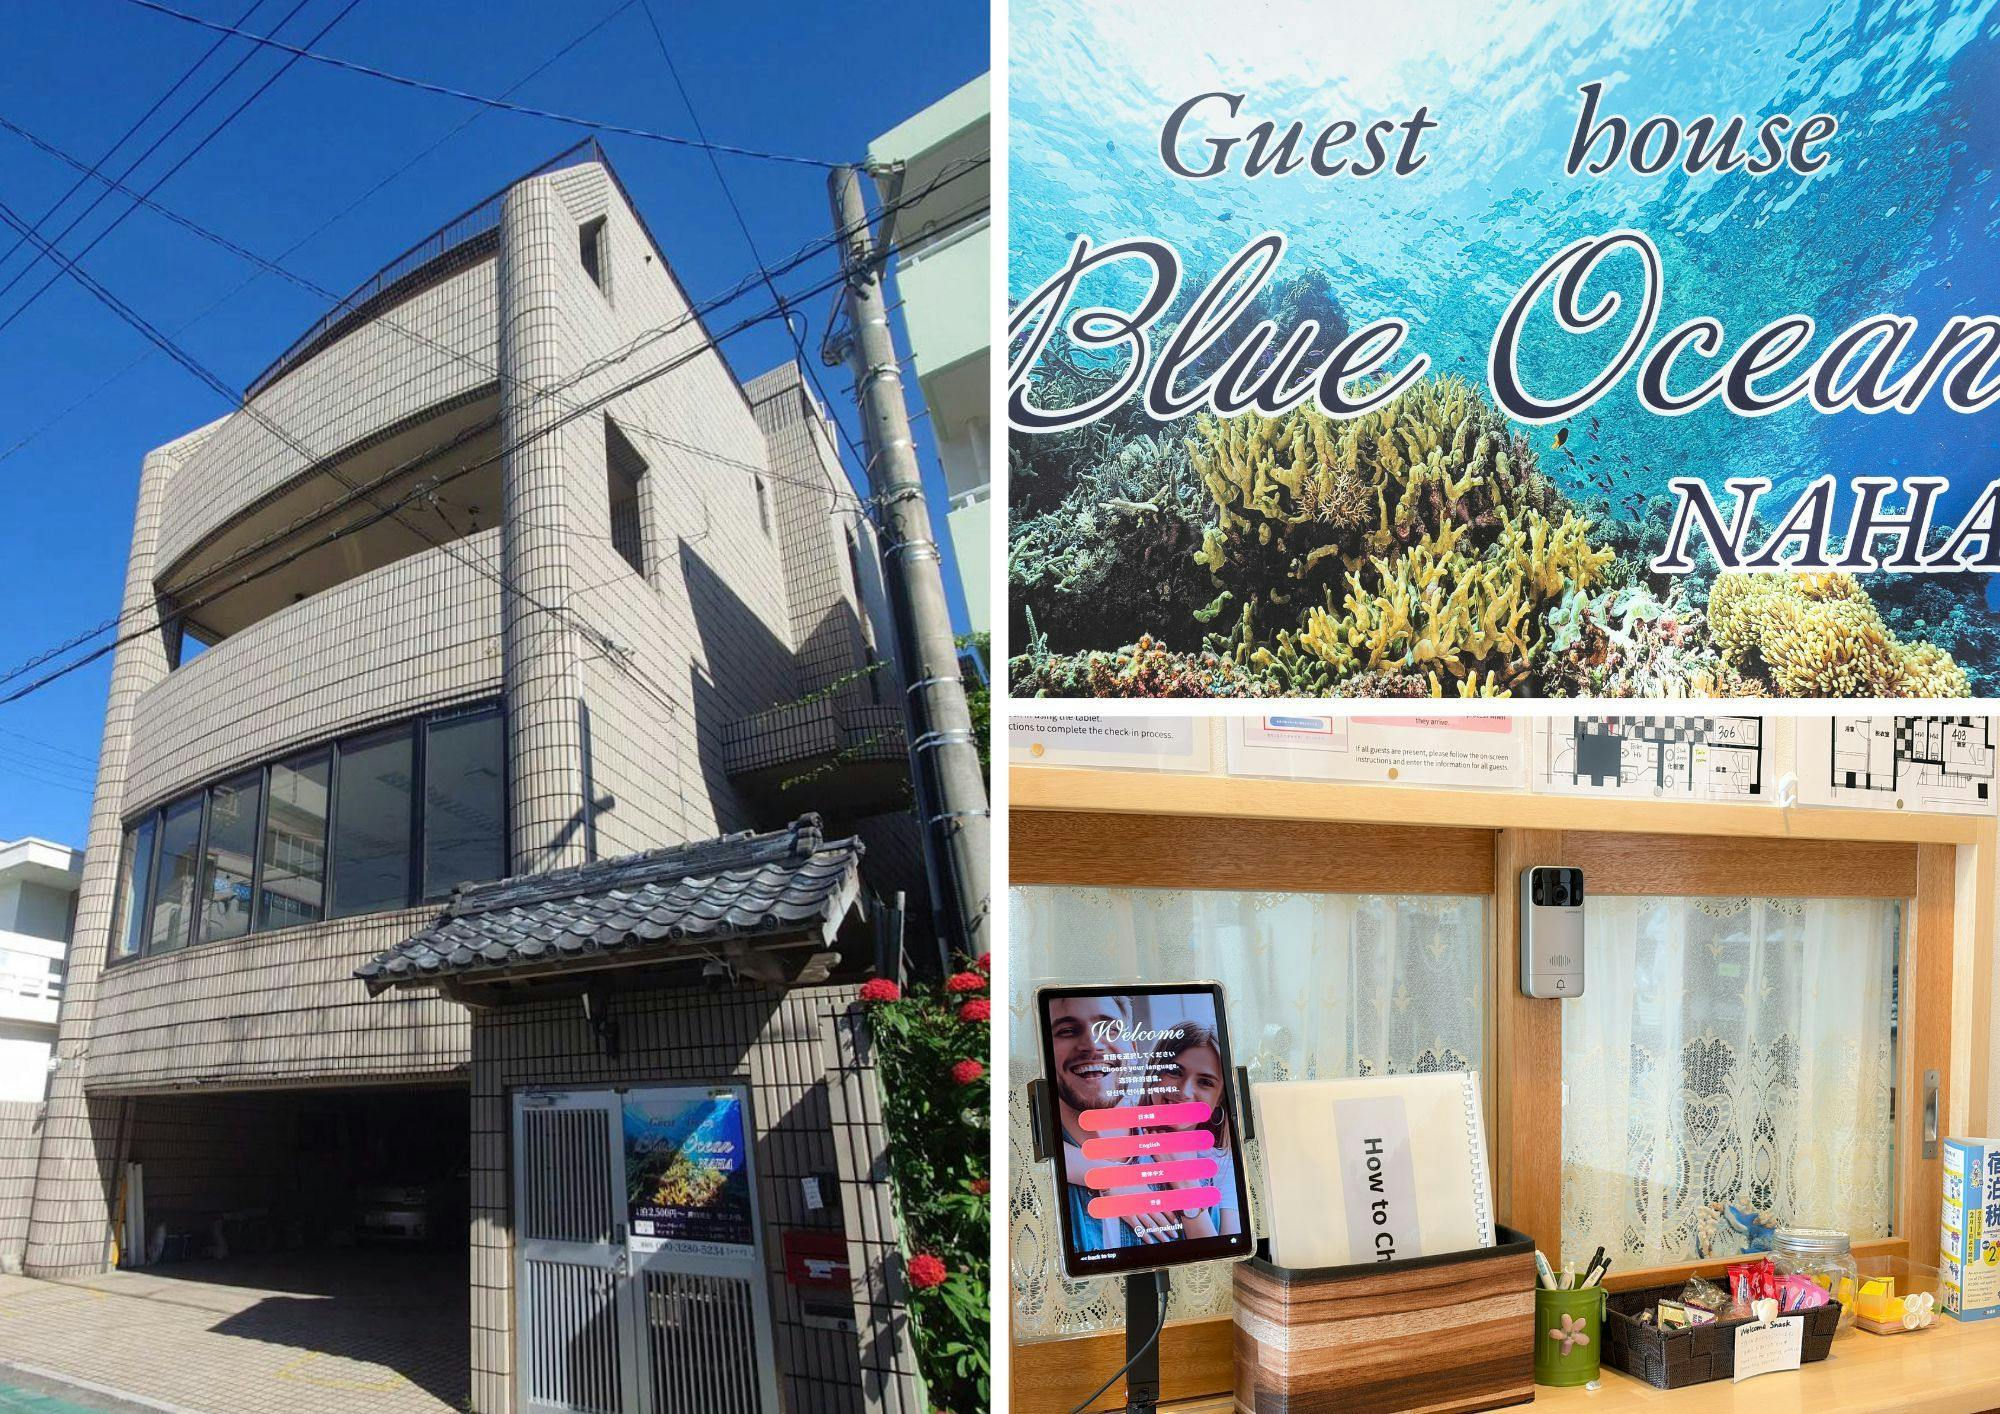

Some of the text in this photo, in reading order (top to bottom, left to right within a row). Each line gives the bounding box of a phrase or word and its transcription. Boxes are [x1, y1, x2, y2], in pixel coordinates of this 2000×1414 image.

[1162, 83, 1837, 176] Guest house
[1008, 234, 2000, 425] Blue Ocean
[1655, 480, 2000, 568] NAHA
[1415, 717, 1429, 726] they
[1036, 724, 1045, 732] to
[1047, 725, 1087, 735] complete
[1089, 726, 1103, 735] the
[1105, 727, 1139, 737] check-in
[1141, 730, 1174, 739] process.
[1717, 725, 1736, 740] 306
[1951, 728, 1967, 741] 403
[1361, 745, 1369, 753] all
[1370, 746, 1390, 755] guests
[1402, 749, 1428, 758] present,
[1429, 749, 1449, 759] please
[1449, 750, 1468, 758] follow
[1436, 760, 1471, 769] information
[1480, 762, 1488, 770] all
[1091, 1019, 1185, 1044] Welcome
[1103, 1051, 1176, 1061] 言語を選択してください
[1101, 1063, 1180, 1073] Choose your language.
[682, 1131, 734, 1154] Ocean
[1138, 1141, 1161, 1149] English
[1363, 1137, 1385, 1193] How
[1371, 1198, 1389, 1226] to
[1087, 1253, 1101, 1261] back
[1107, 1252, 1117, 1261] top
[1740, 1323, 1767, 1337] Welcome
